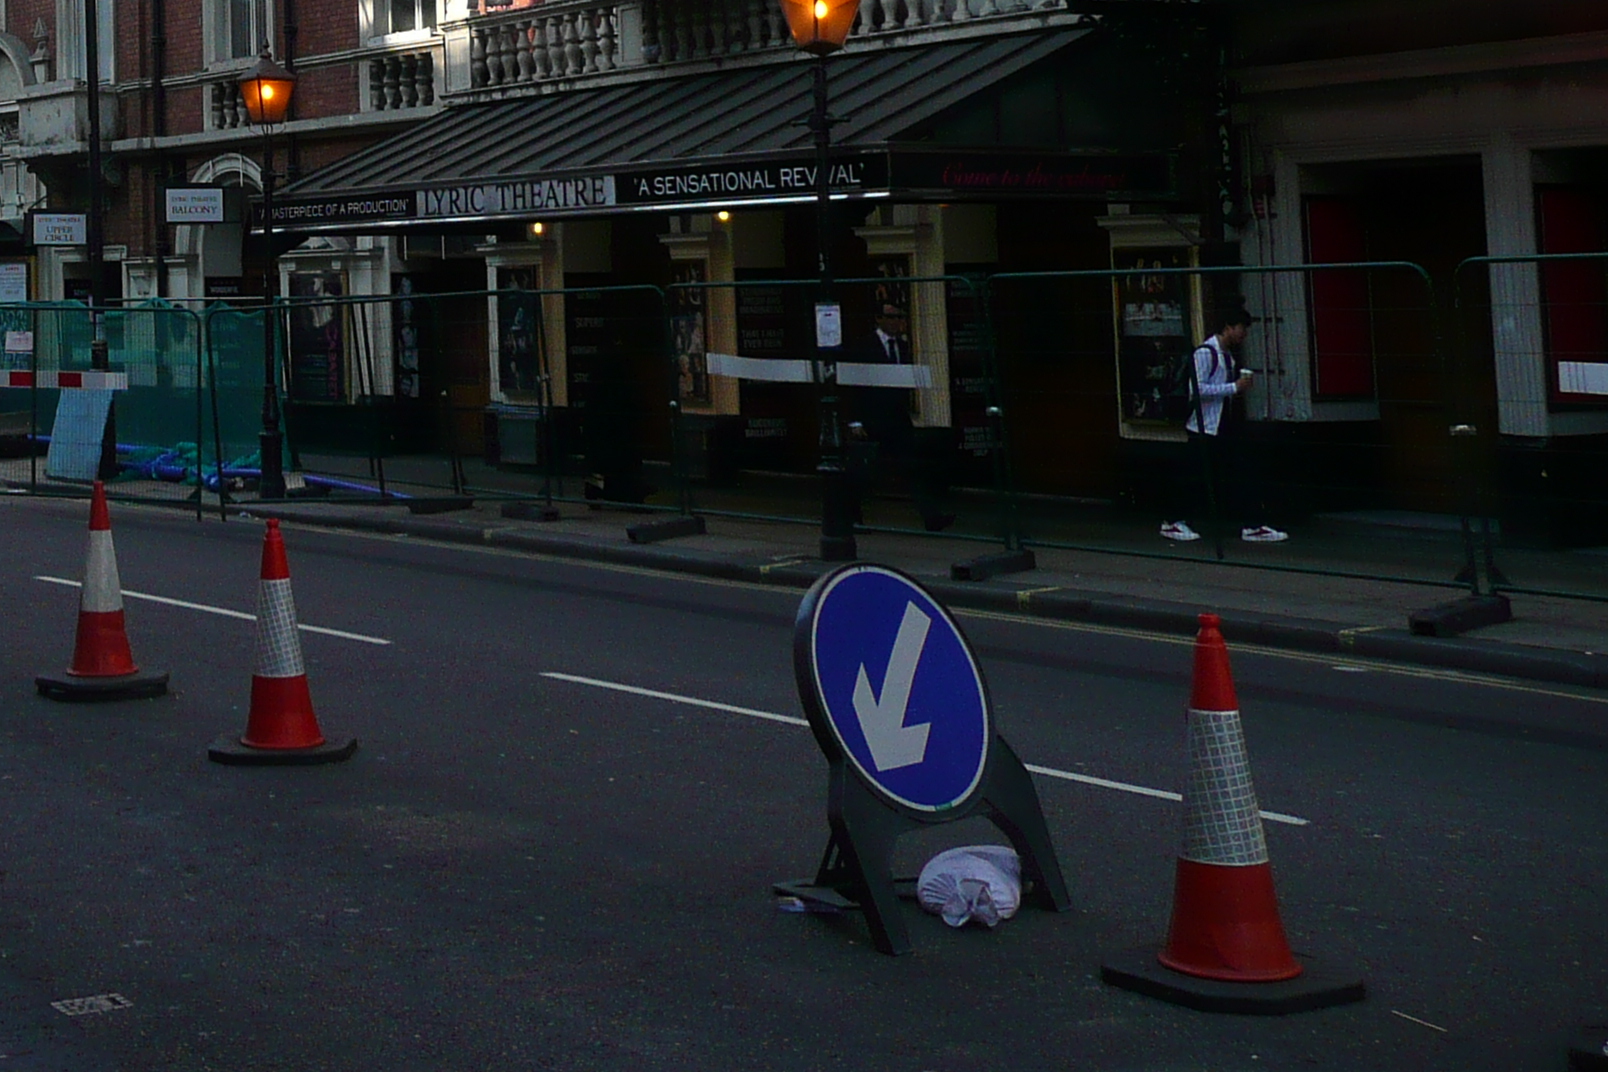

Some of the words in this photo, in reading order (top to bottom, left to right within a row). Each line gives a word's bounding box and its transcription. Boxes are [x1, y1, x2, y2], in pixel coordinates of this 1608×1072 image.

[653, 170, 776, 195] SENSATIONAL
[423, 188, 486, 216] LYRIC
[496, 177, 606, 212] THEATRE
[171, 205, 218, 215] BALCONY
[325, 203, 338, 216] OF
[339, 203, 346, 215] A
